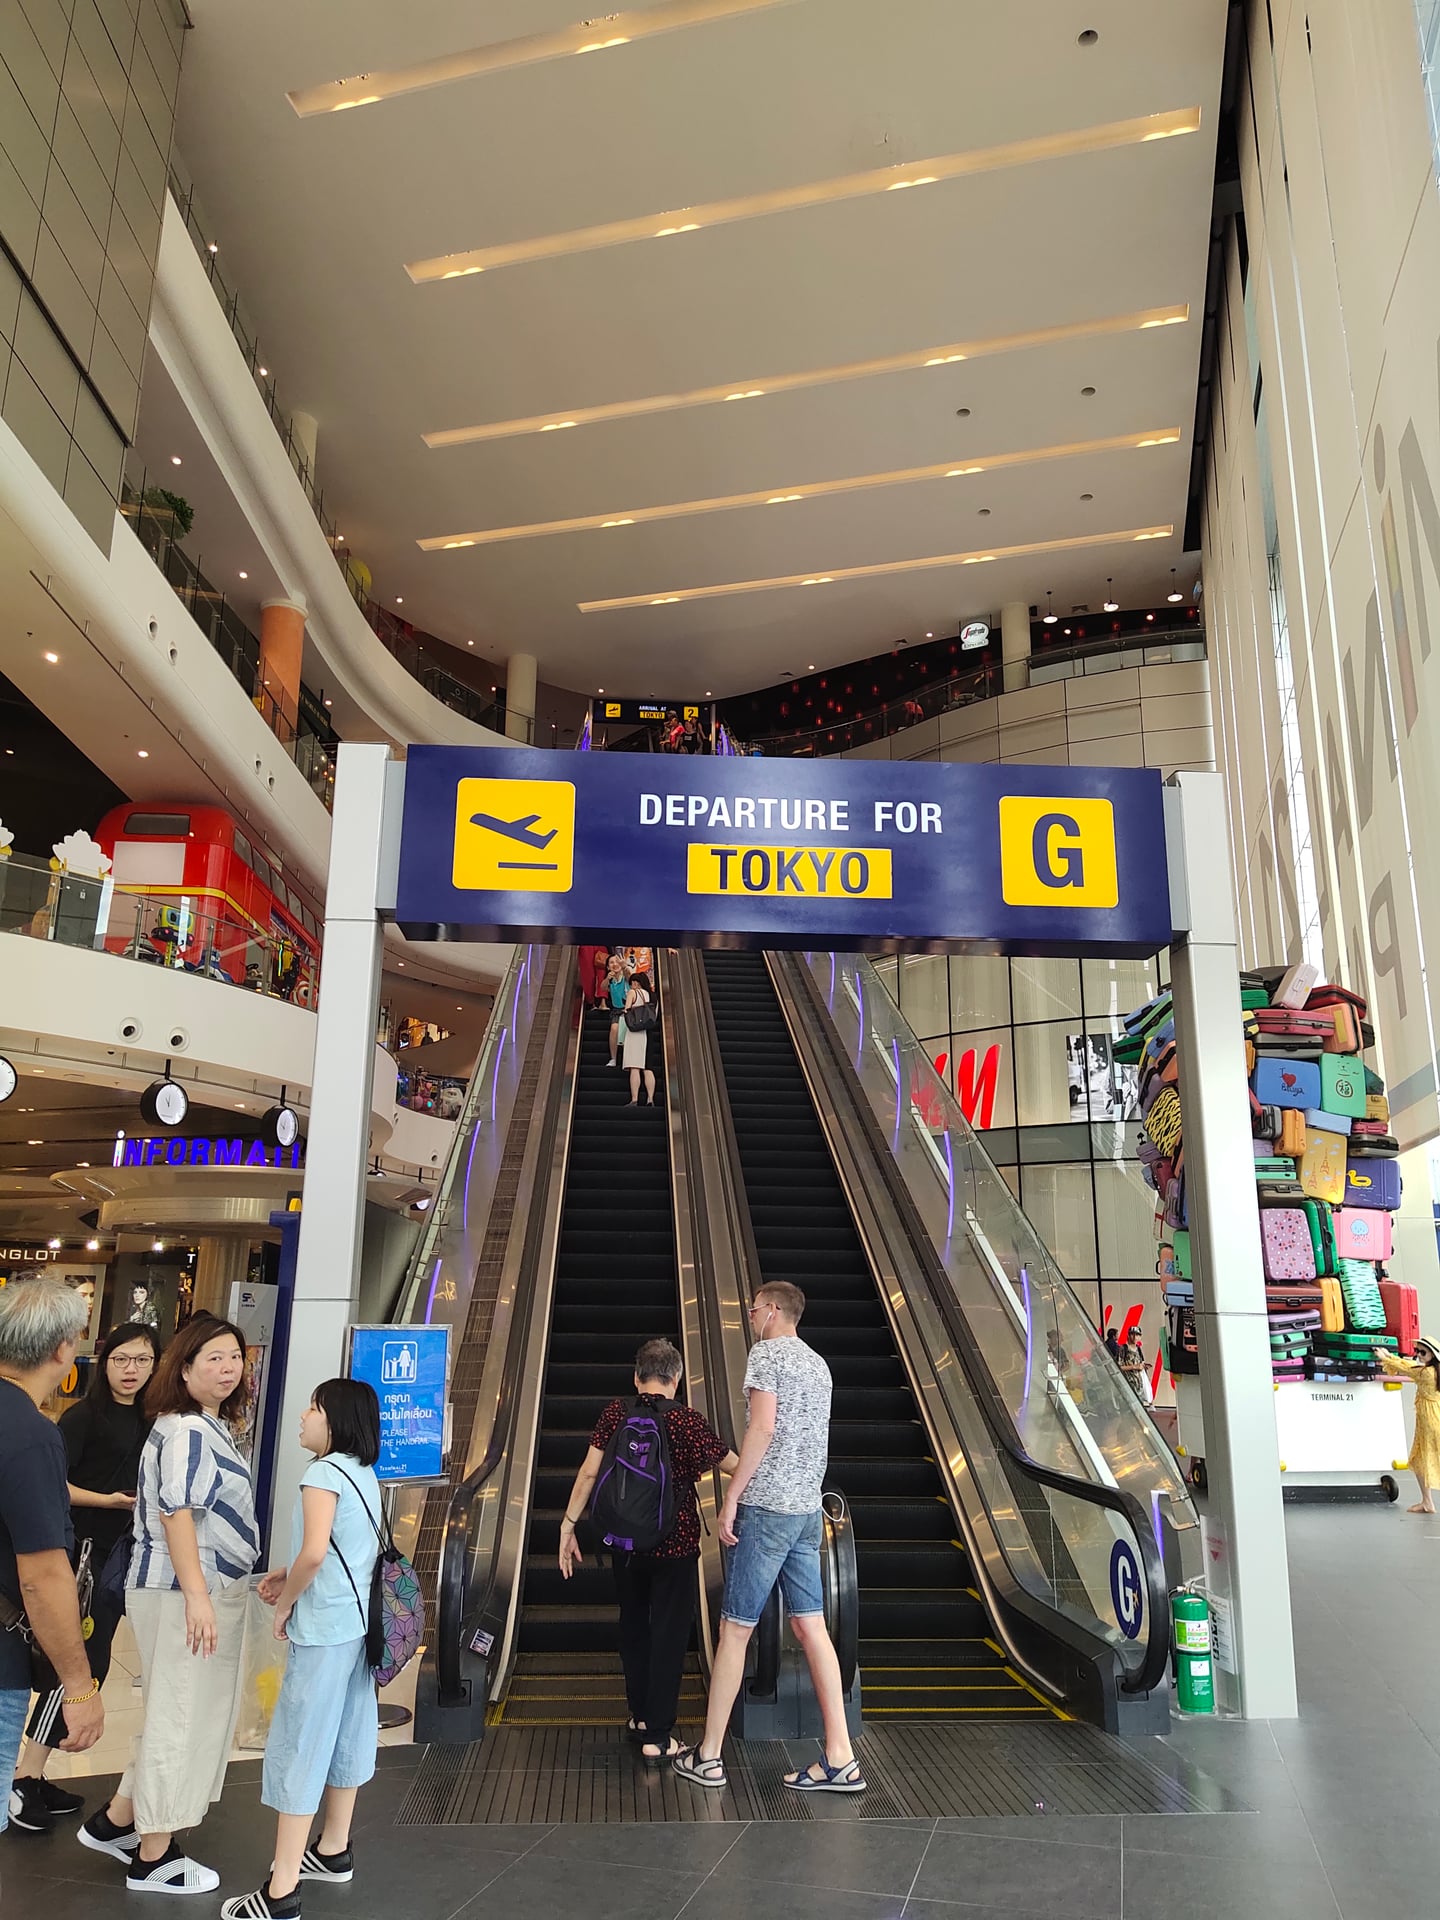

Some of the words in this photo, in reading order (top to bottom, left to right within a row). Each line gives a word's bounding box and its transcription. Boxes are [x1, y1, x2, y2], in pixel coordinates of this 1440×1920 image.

[688, 709, 694, 719] 2
[640, 794, 850, 831] DEPARTURE
[874, 801, 943, 834] FOR
[1032, 813, 1085, 888] G
[710, 848, 870, 893] TOKYO
[384, 1393, 411, 1406] กรุณา
[1311, 1393, 1345, 1401] TERMINAL
[1346, 1393, 1354, 1401] 21
[382, 1428, 409, 1438] PLEASE
[380, 1439, 394, 1447] THE
[395, 1435, 431, 1447] HANDRAIL
[1117, 1555, 1136, 1625] G
